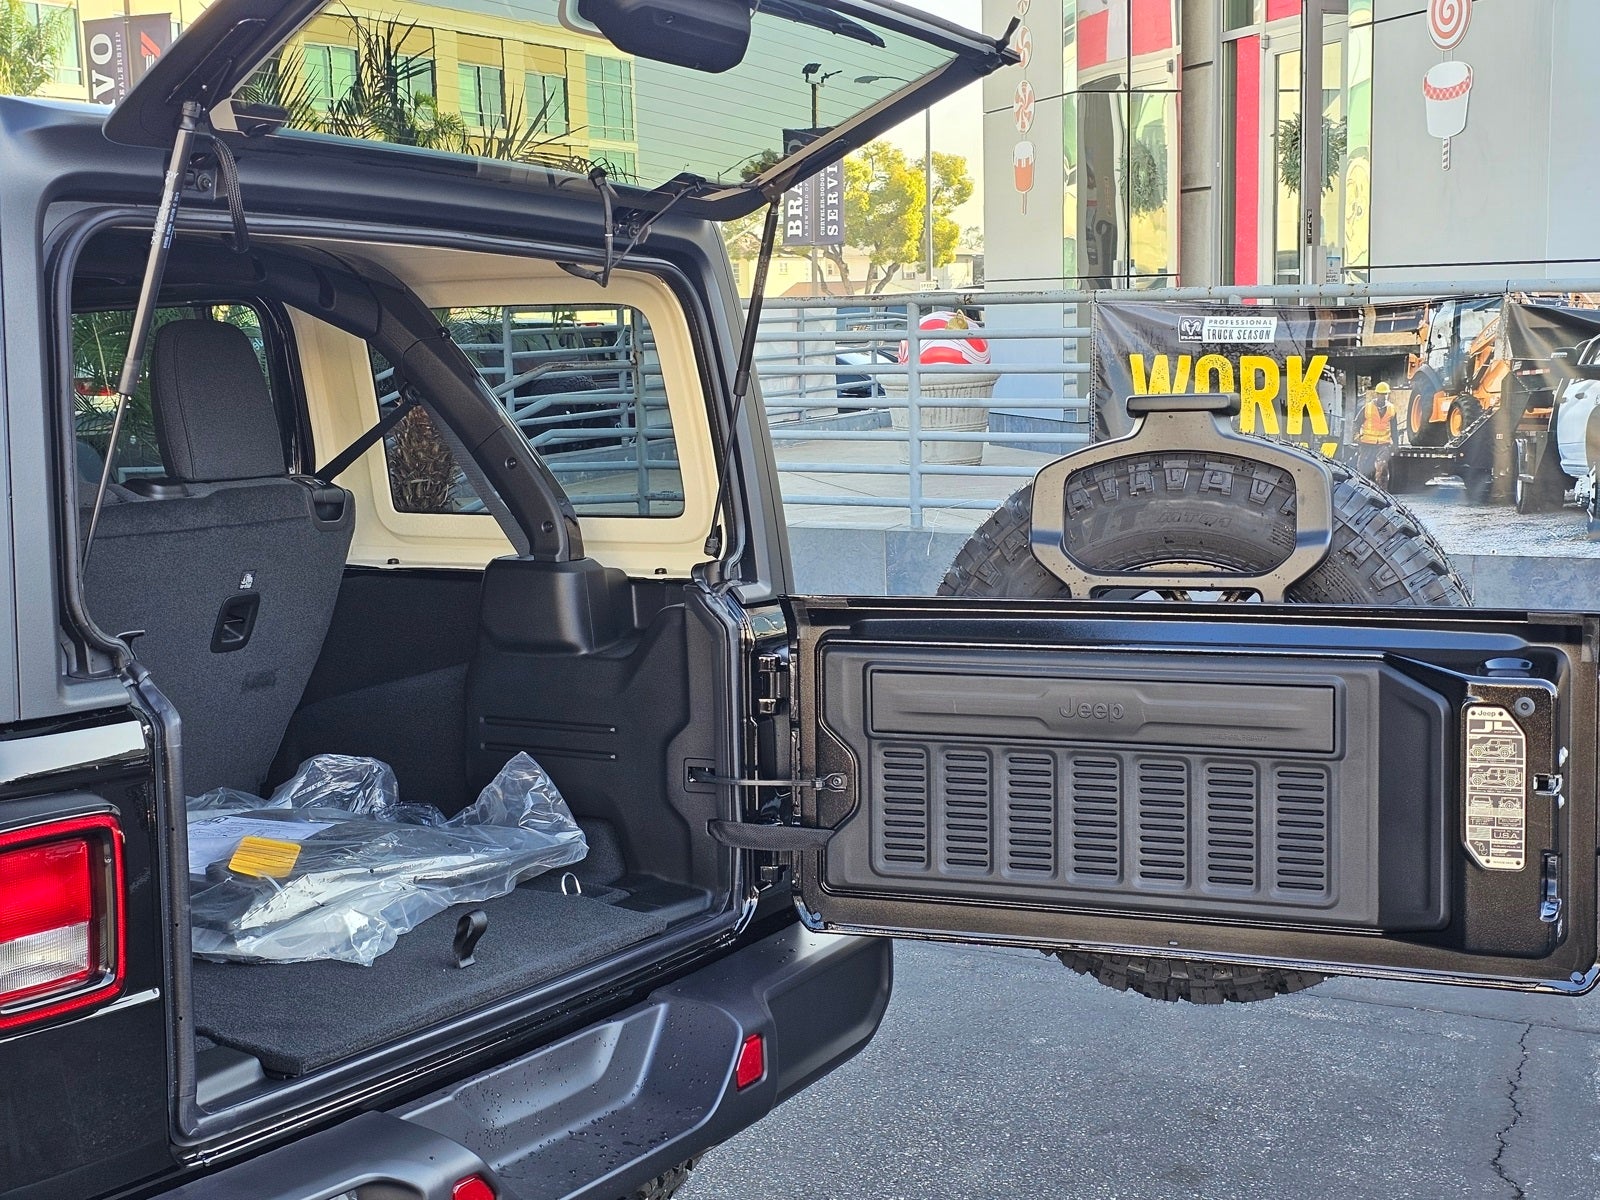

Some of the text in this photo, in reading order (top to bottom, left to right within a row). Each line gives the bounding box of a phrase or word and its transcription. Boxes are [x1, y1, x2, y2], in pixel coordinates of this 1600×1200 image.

[1207, 328, 1272, 341] TRUCK SEASON
[1059, 698, 1124, 723] Jeep
